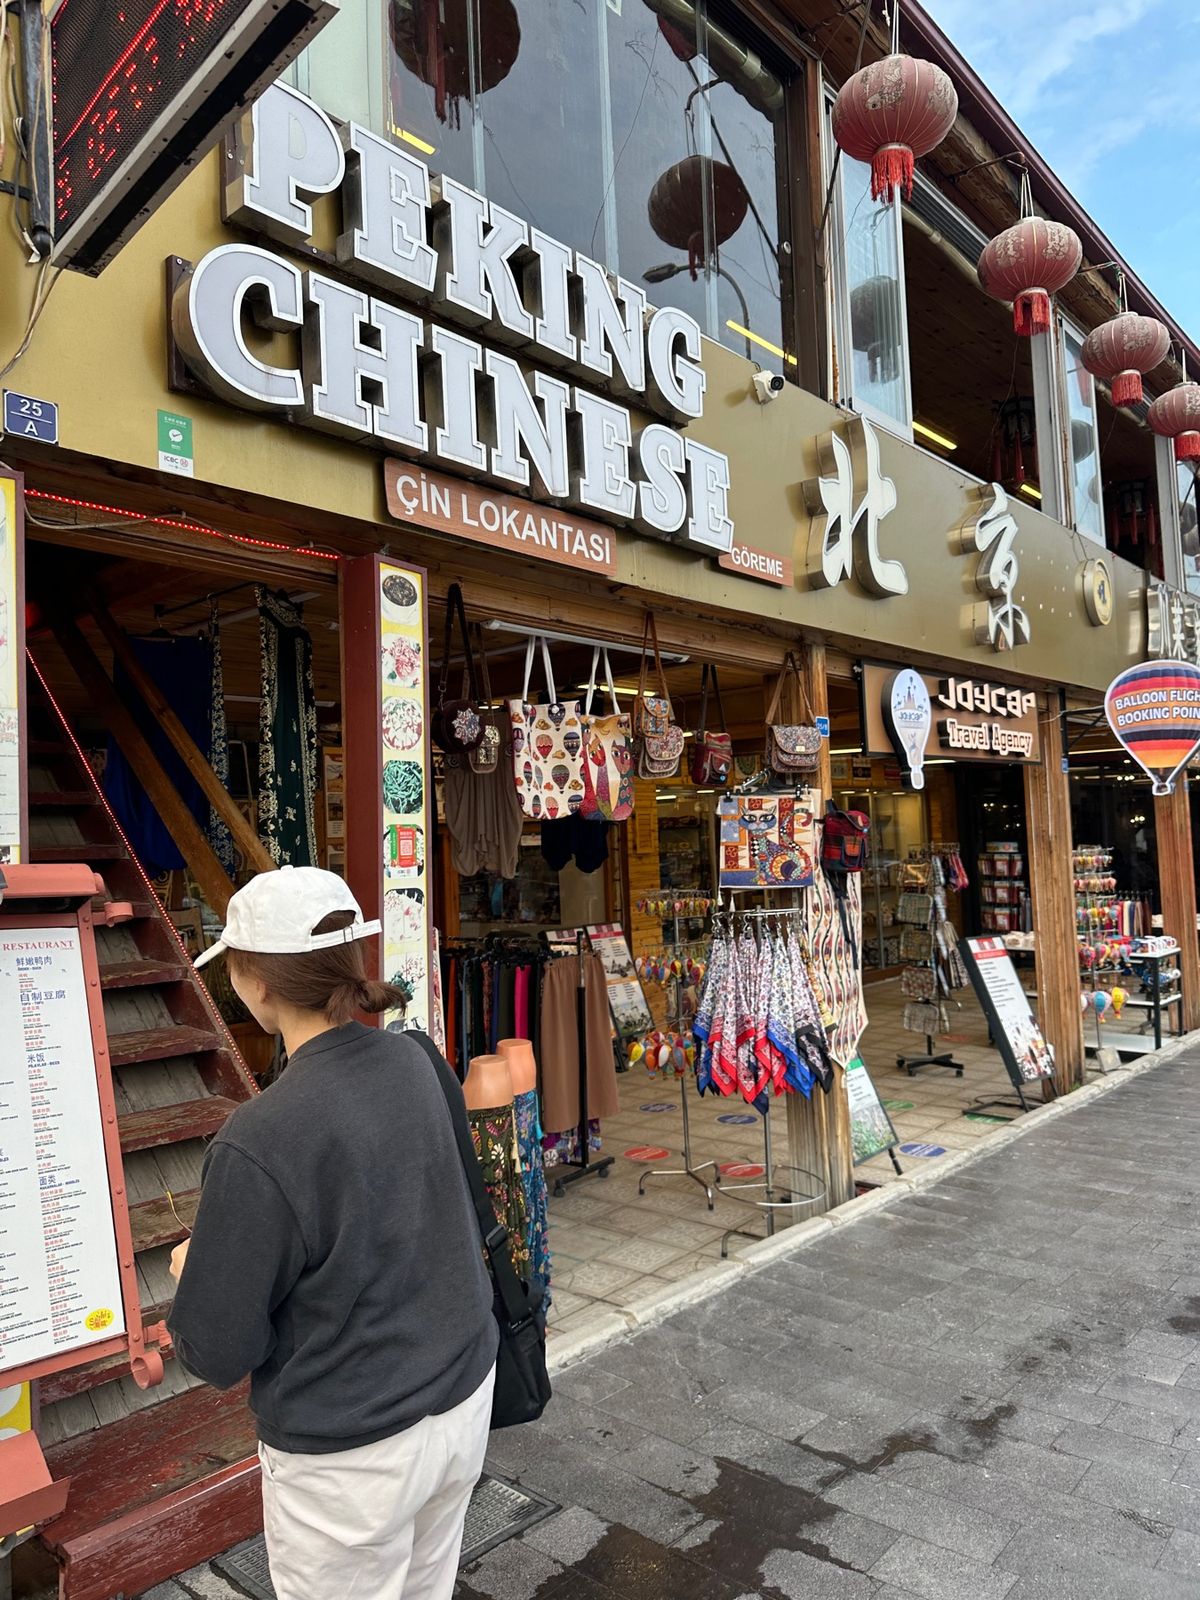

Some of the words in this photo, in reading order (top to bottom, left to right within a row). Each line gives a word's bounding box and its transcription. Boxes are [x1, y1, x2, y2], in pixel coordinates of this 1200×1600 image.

[243, 80, 706, 419] PEKING
[20, 399, 42, 417] 25
[187, 243, 735, 554] CHINESE
[25, 421, 38, 436] A
[396, 473, 451, 519] ÇİN
[461, 493, 611, 565] LOKANTASI
[731, 546, 784, 578] GÖREME
[1115, 691, 1168, 710] BALLOON
[1117, 707, 1170, 727] BOOKING
[948, 719, 989, 748] Travel
[992, 723, 1034, 757] Agency
[3, 940, 74, 951] RESTAURANT
[20, 990, 66, 1002] 自制豆腐
[27, 1053, 45, 1064] 米饭
[39, 1174, 56, 1186] 面类
